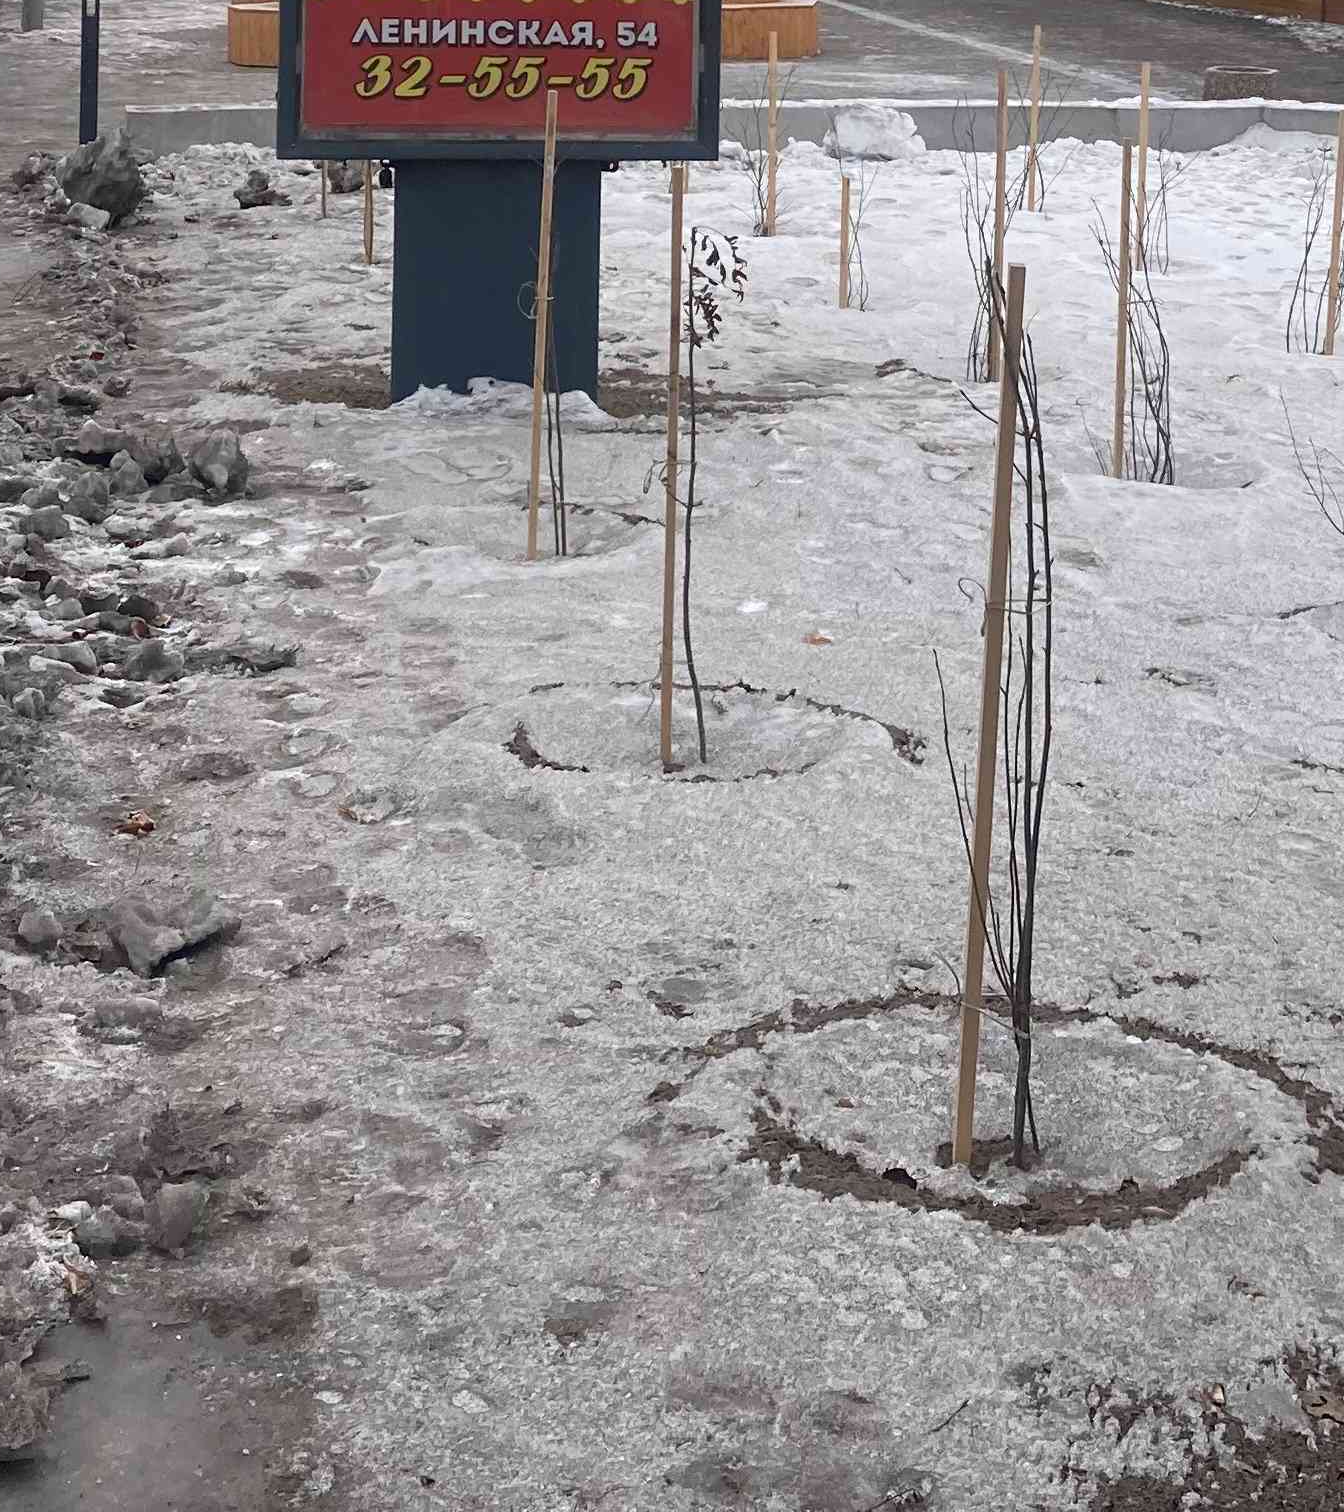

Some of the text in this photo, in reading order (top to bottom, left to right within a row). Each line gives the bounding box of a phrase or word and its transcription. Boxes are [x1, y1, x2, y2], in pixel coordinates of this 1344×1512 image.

[352, 18, 658, 48] ЛЕНИНСКАЯ, 54
[355, 54, 654, 99] 32-55-55
